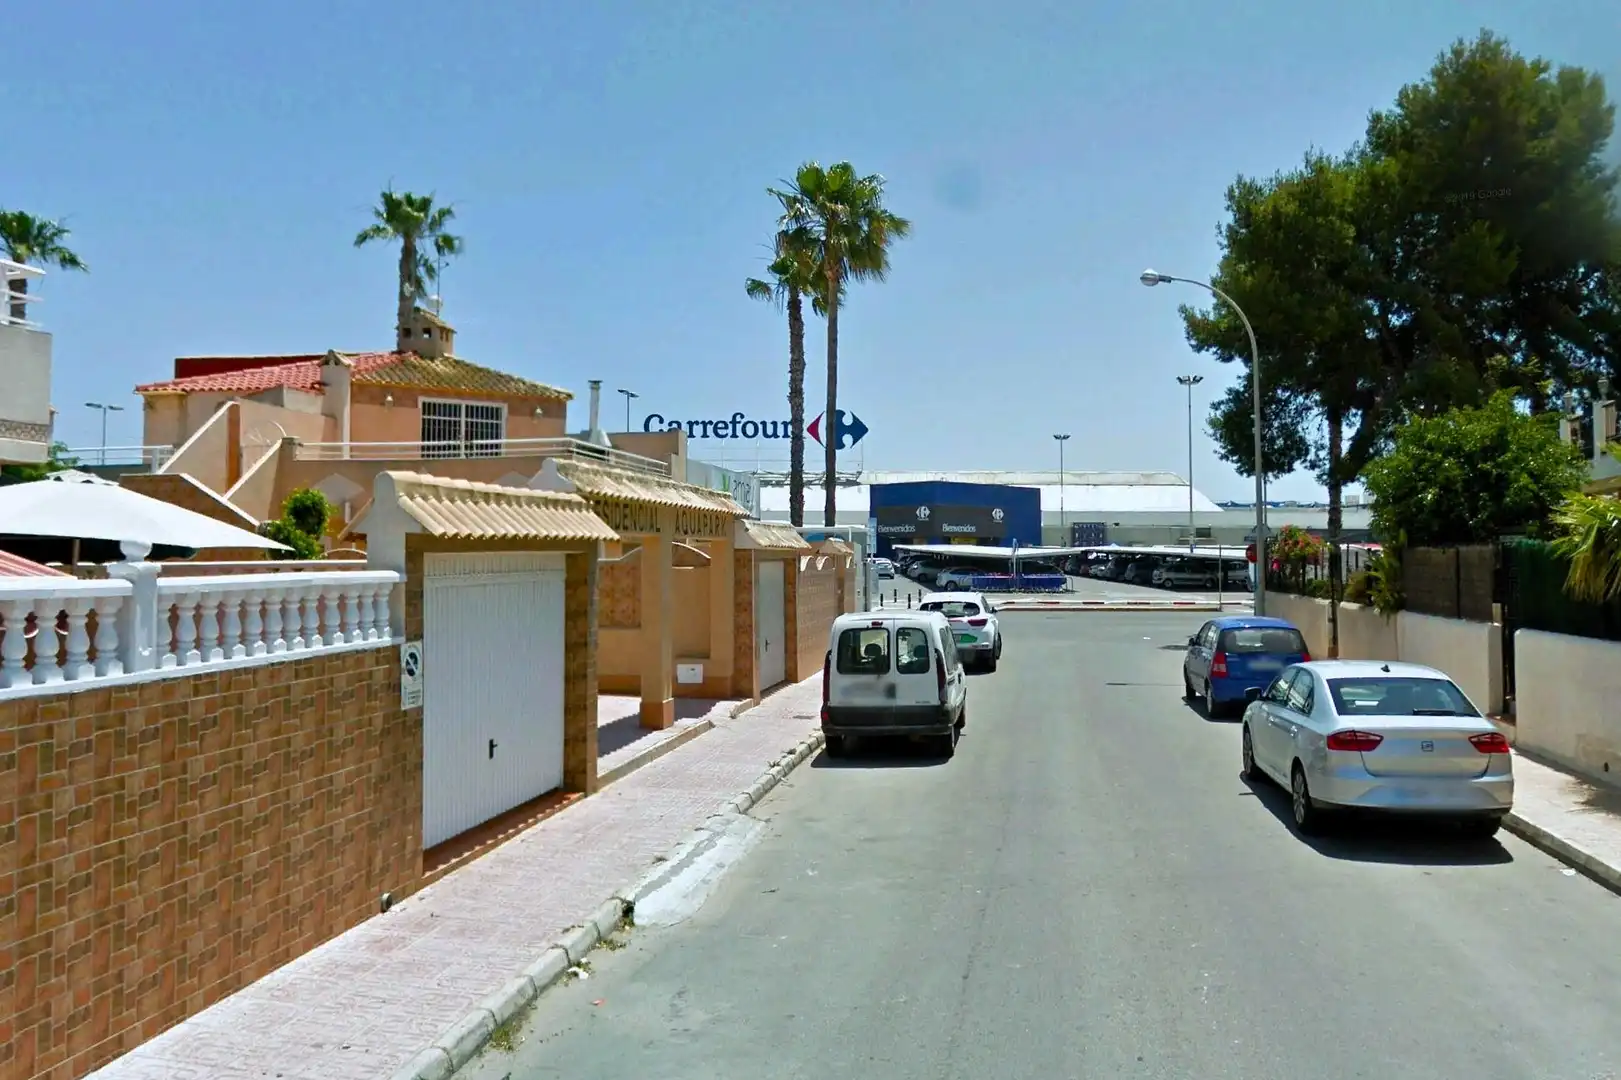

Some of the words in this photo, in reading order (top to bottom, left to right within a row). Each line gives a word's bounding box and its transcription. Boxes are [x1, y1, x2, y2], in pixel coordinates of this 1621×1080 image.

[643, 412, 792, 439] Carrefour
[675, 508, 727, 537] AQUAPARK
[878, 523, 916, 533] Bienvenidos
[942, 522, 976, 533] Bienvenidos
